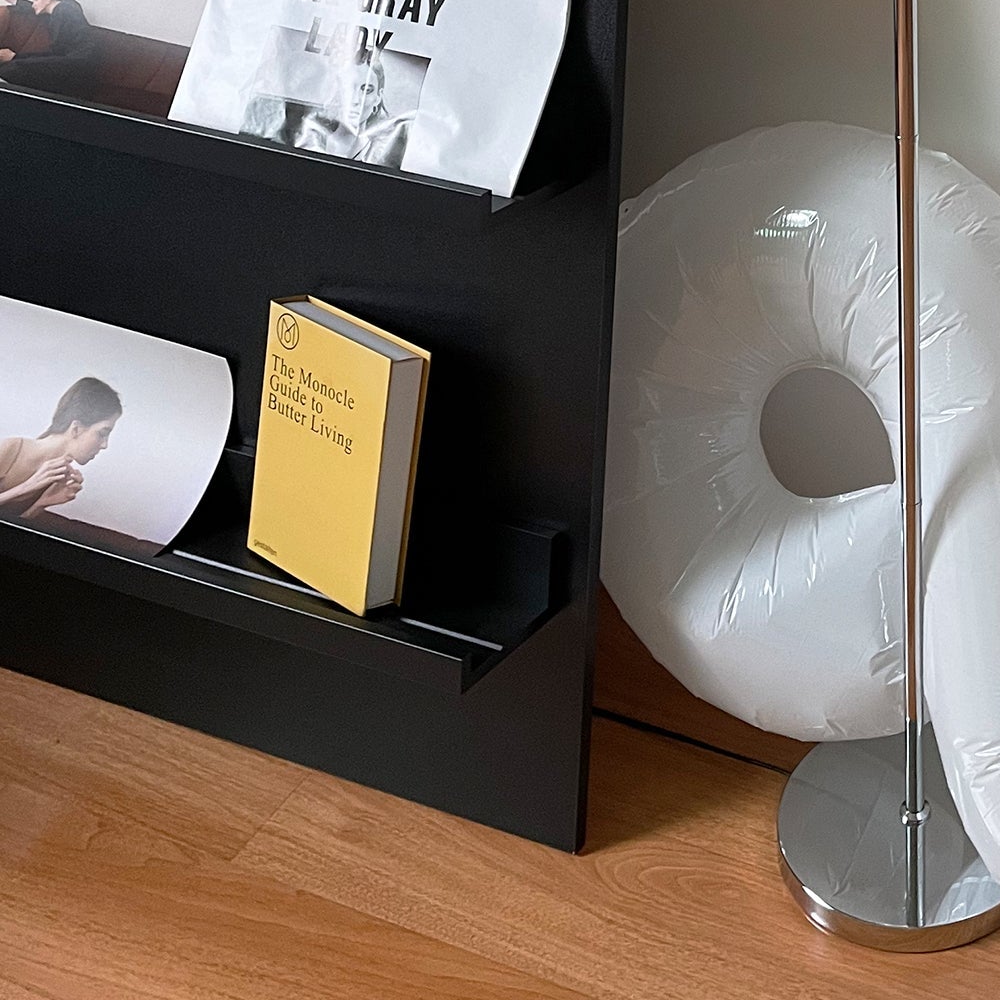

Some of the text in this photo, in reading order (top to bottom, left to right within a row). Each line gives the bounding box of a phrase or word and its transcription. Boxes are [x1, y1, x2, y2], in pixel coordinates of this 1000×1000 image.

[269, 374, 323, 414] Guide to
[271, 353, 355, 410] The Monocle
[267, 392, 353, 455] Butter Living
